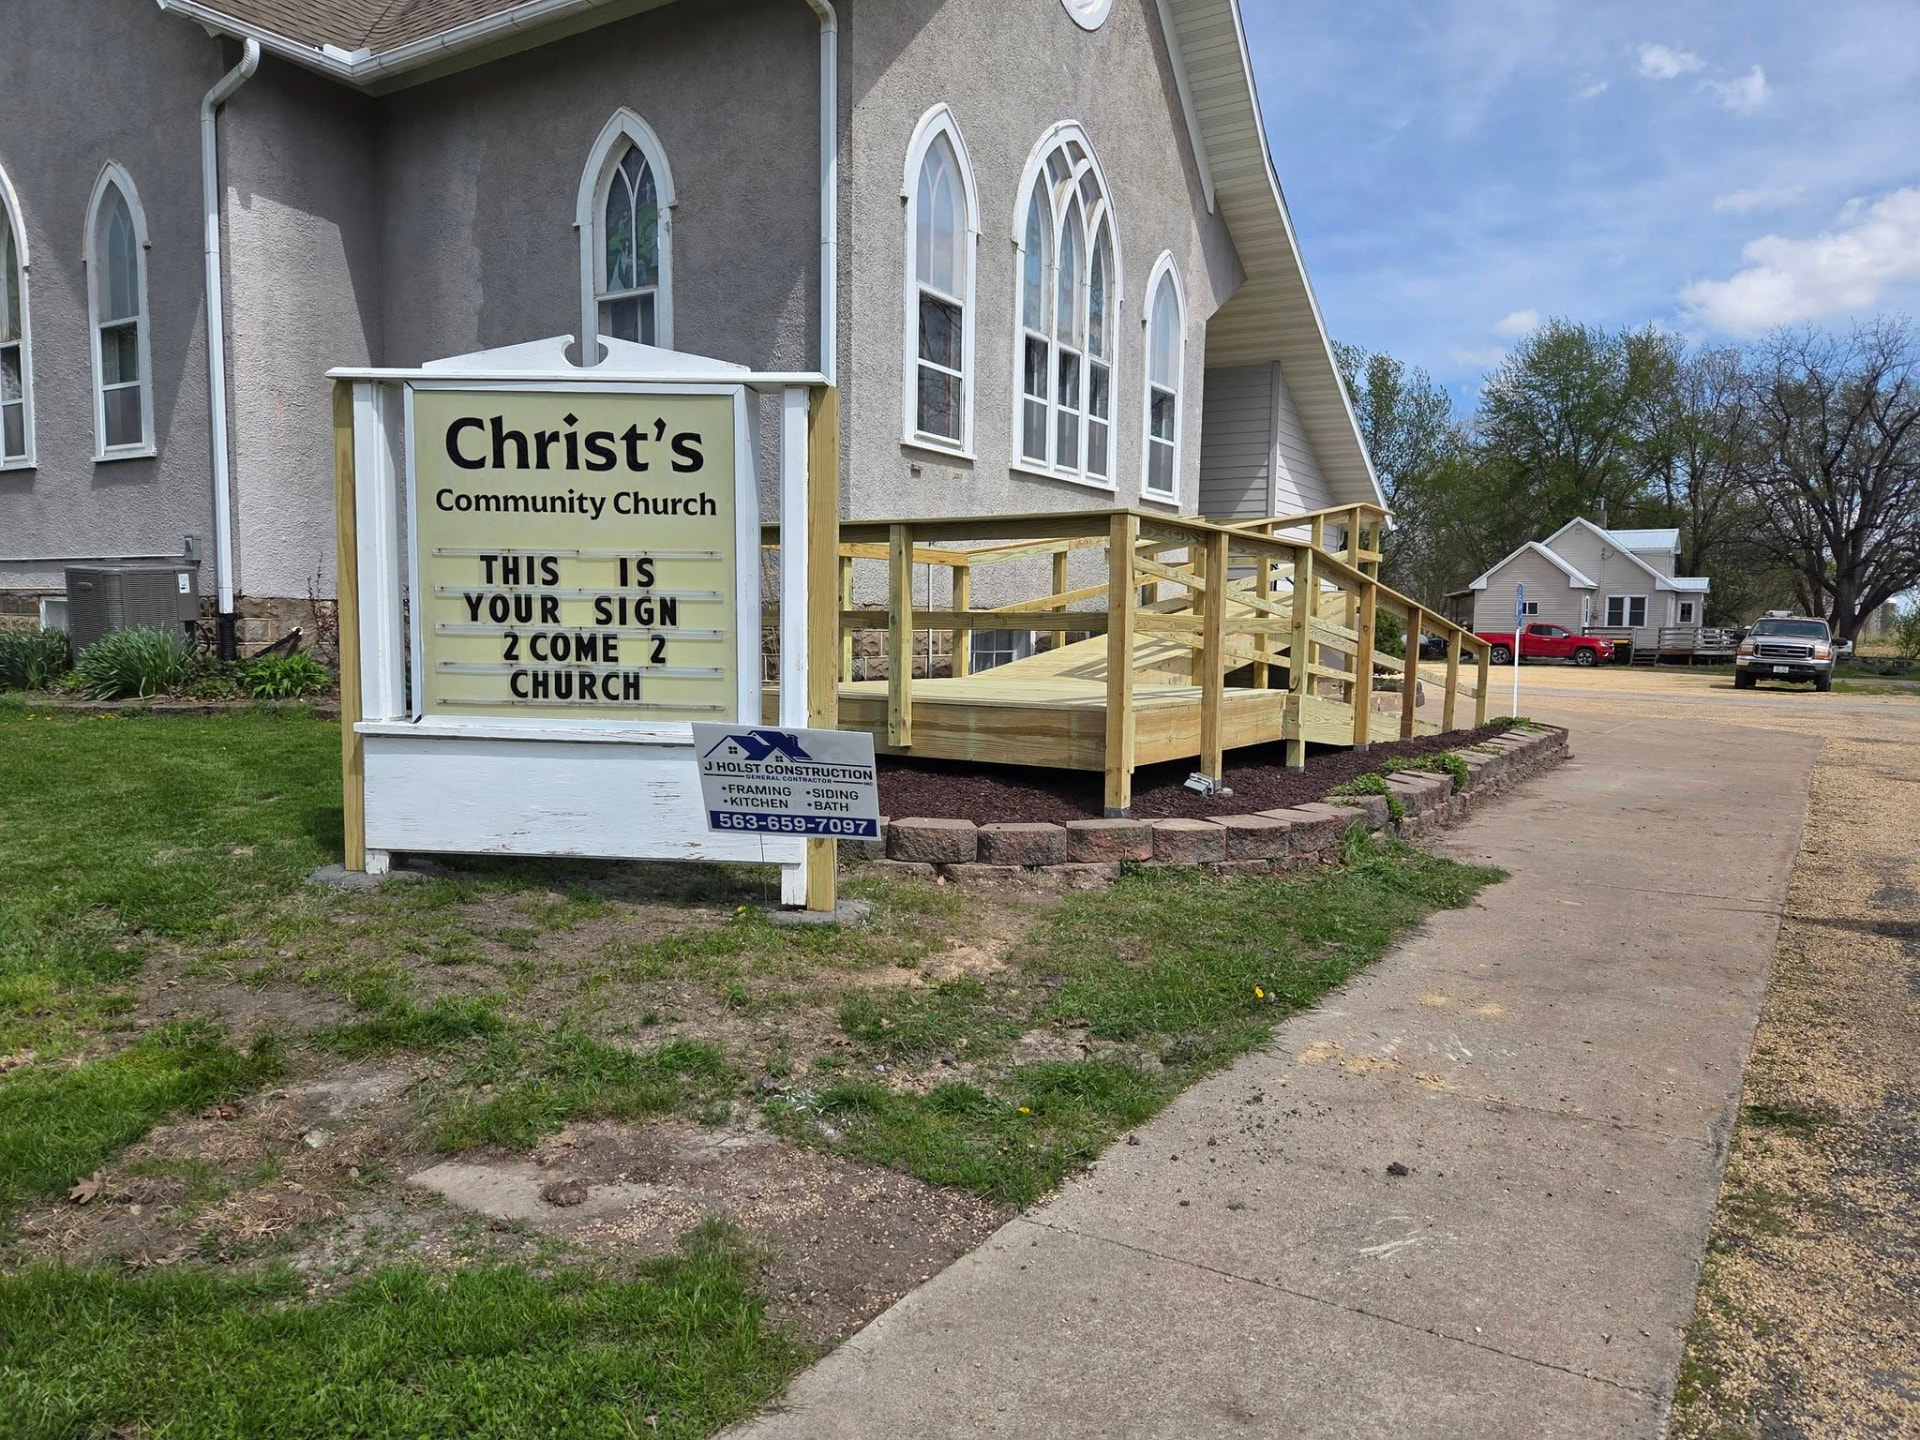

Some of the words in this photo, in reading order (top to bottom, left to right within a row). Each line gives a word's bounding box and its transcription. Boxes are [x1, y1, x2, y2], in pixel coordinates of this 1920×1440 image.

[446, 413, 704, 473] Christ's
[436, 488, 606, 520] Community
[613, 491, 717, 516] Church
[480, 555, 559, 585] THIS
[619, 557, 655, 587] IS
[463, 593, 560, 623] YOUR
[594, 596, 678, 626] SIGN
[650, 634, 666, 664] 2
[510, 669, 640, 700] CHURCH
[704, 761, 712, 771] J
[717, 761, 761, 773] HOLST
[764, 764, 873, 780] CONSTRUCTION
[782, 776, 832, 784] CONTRACTOR
[728, 784, 792, 796] FRAMING
[812, 788, 859, 800] SIDING
[730, 797, 789, 809] KITCHEN
[814, 801, 849, 812] BATH
[719, 813, 868, 834] 563-659-7097
